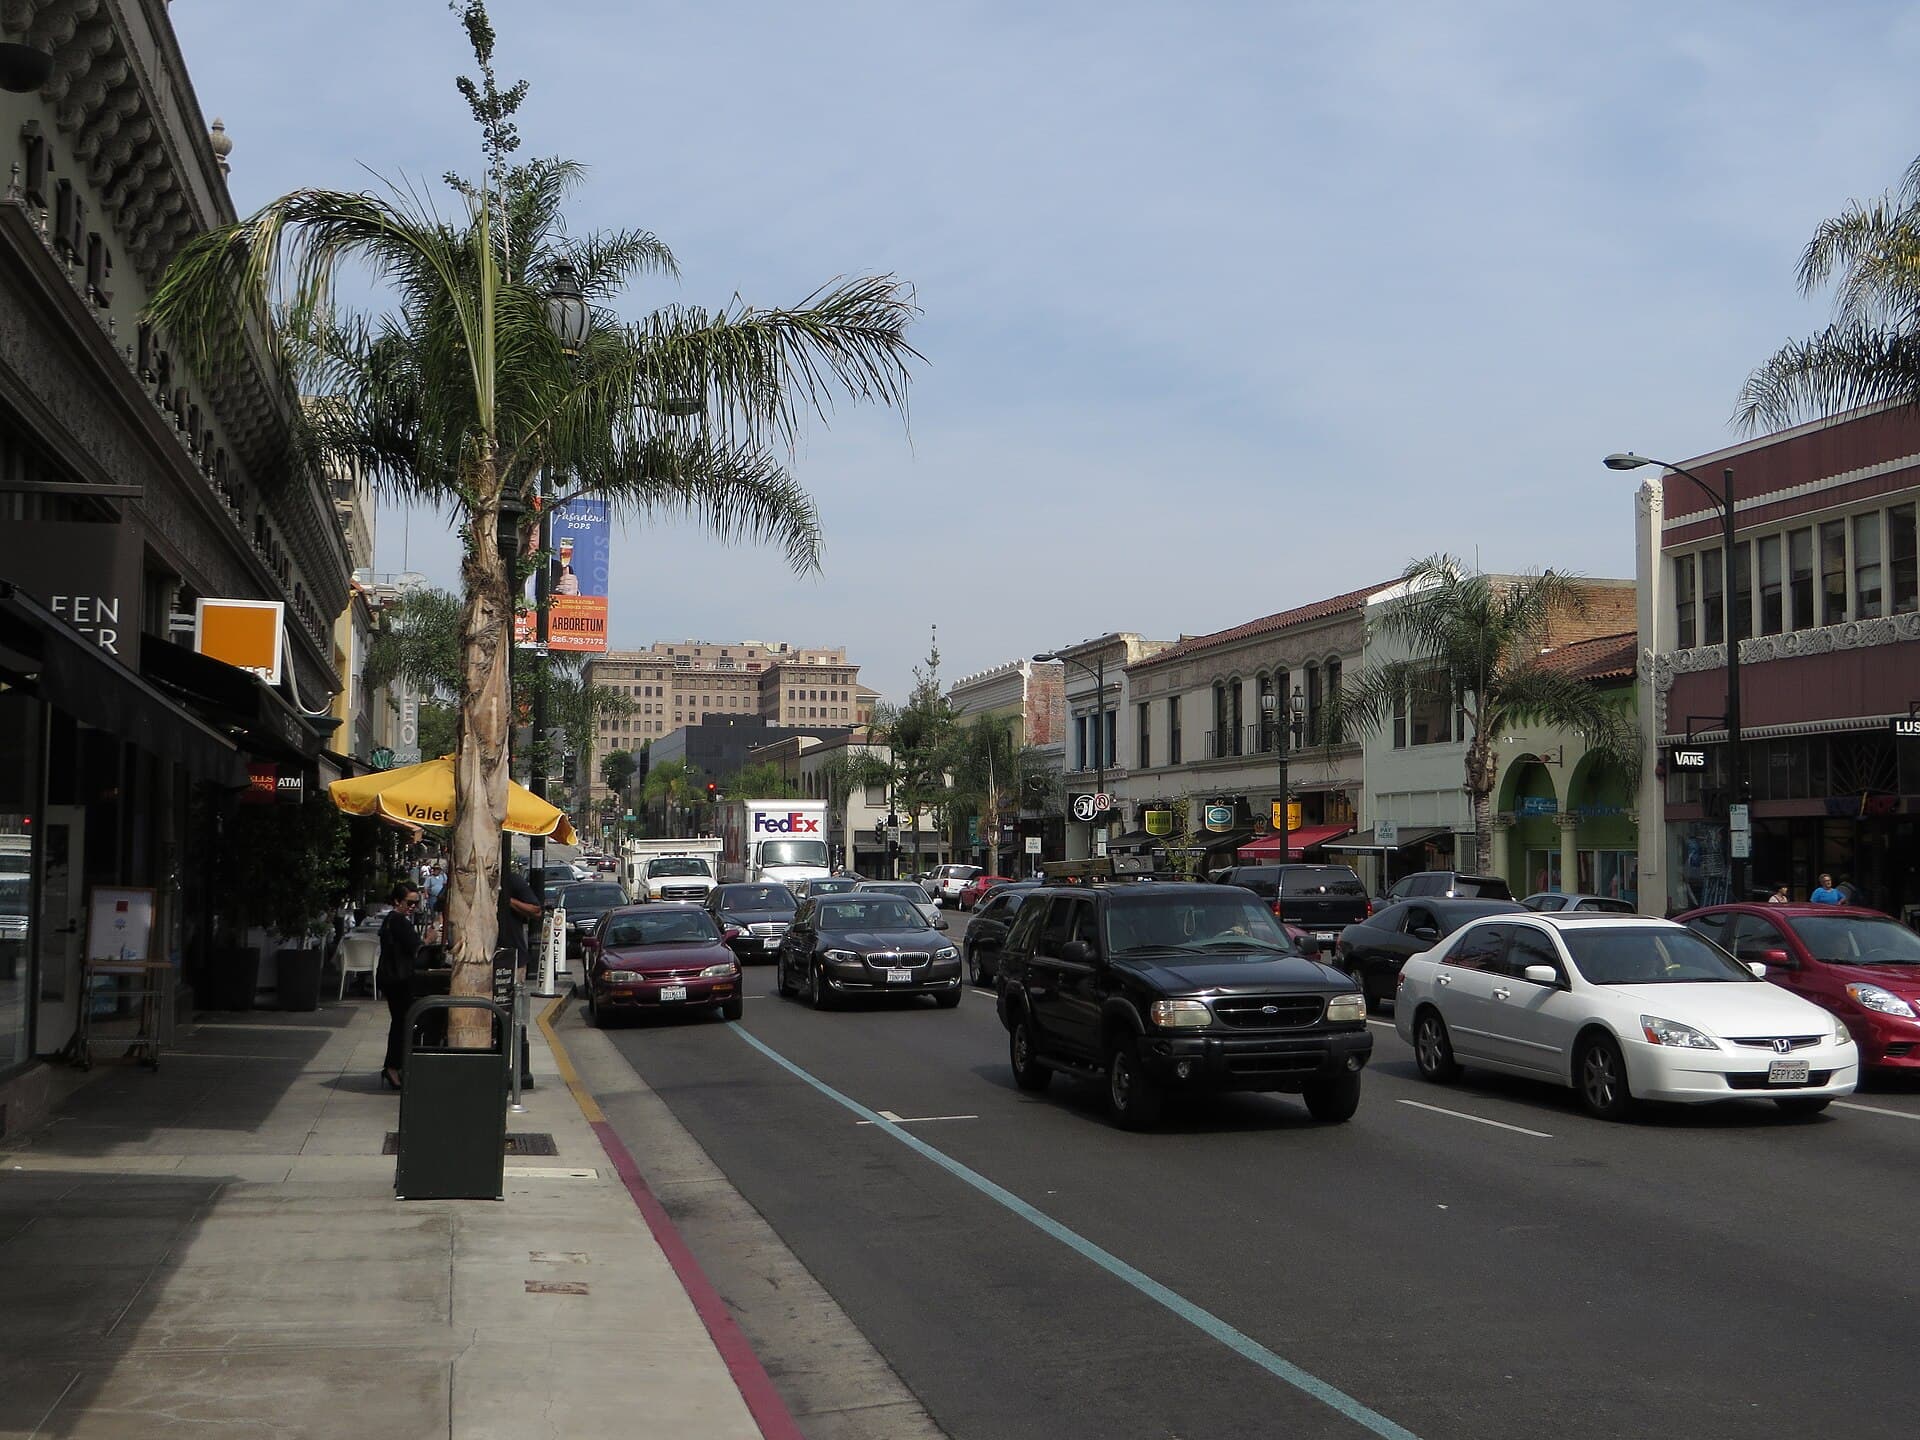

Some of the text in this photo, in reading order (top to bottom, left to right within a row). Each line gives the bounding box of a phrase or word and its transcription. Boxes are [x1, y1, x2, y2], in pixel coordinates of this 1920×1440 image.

[567, 522, 591, 530] POPS
[593, 535, 608, 597] POPS
[552, 616, 604, 632] ARBORETUM
[551, 635, 604, 645] 626.793.7172
[1675, 751, 1705, 766] VANS
[277, 777, 301, 787] ATM
[405, 803, 450, 821] Valet
[754, 812, 819, 833] FedEx
[538, 945, 548, 988] VALET
[1771, 1068, 1806, 1080] 5FPY385
